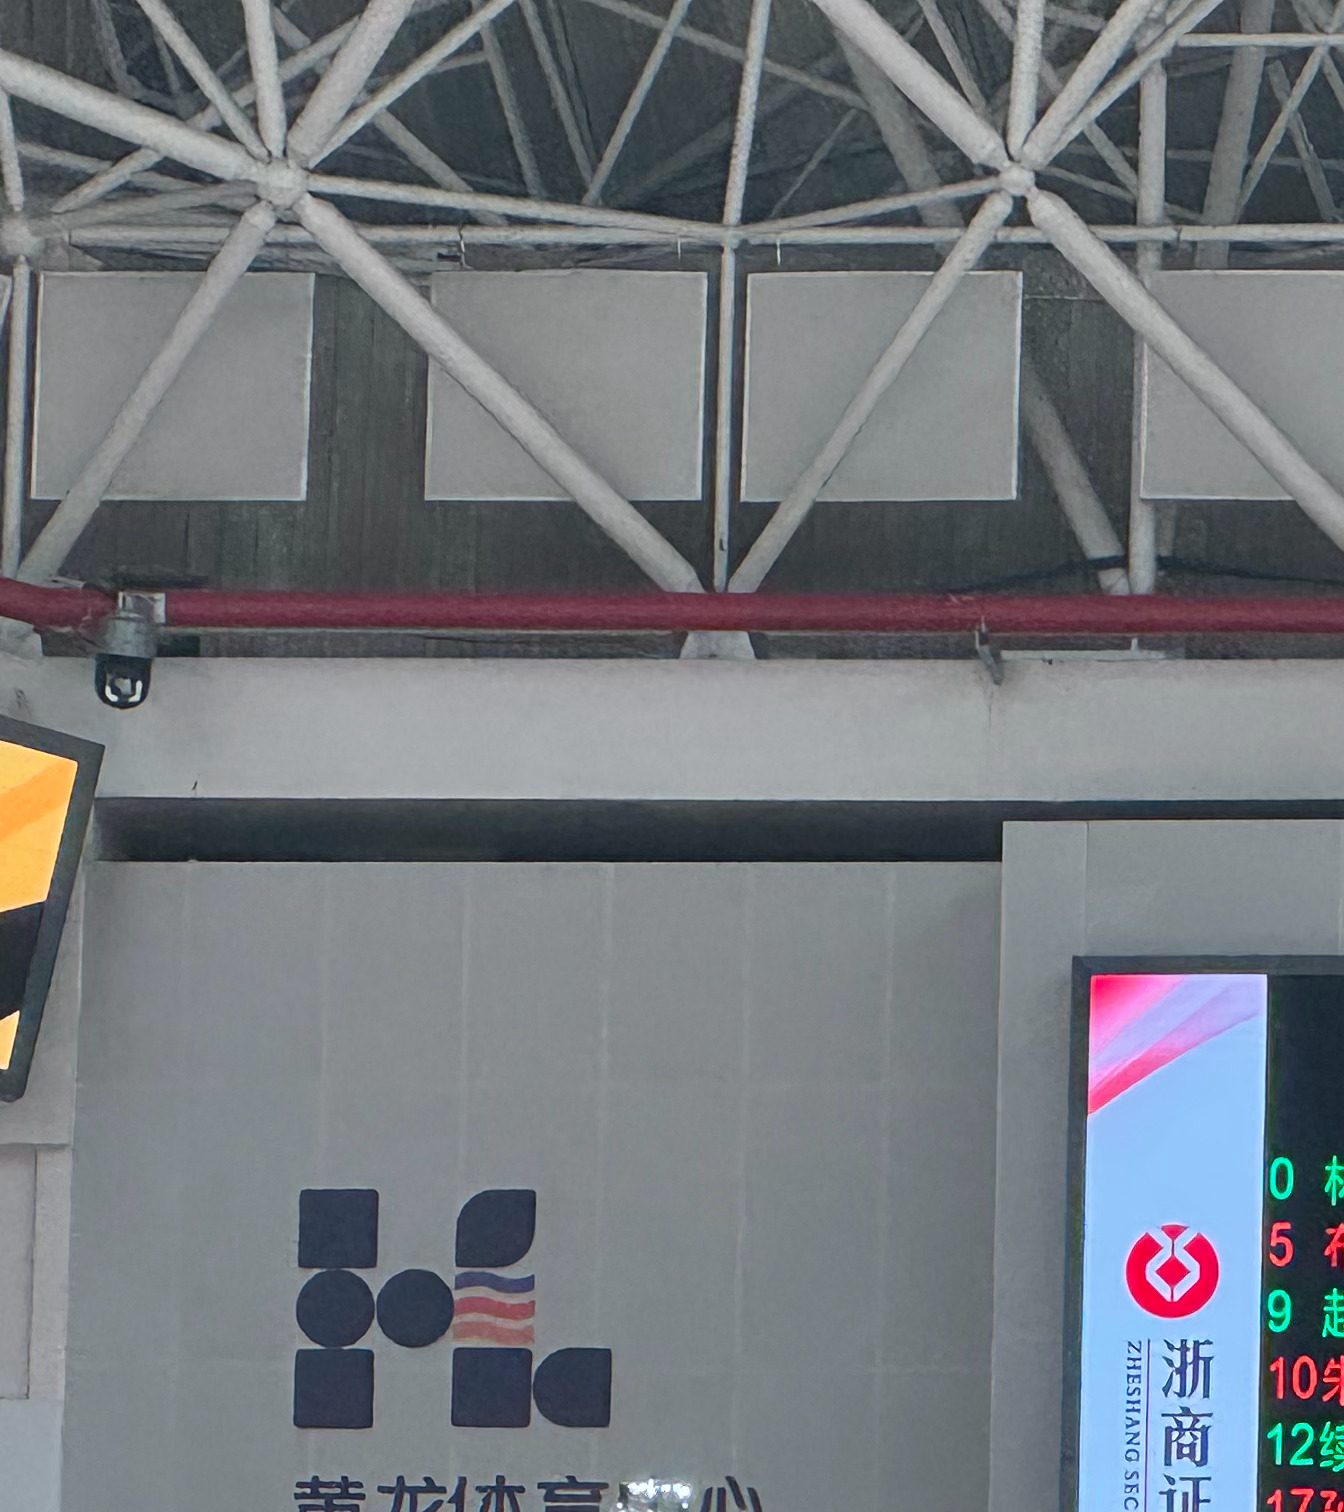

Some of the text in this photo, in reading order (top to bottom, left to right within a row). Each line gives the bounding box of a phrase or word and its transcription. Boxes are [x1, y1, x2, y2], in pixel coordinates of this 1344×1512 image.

[1268, 1156, 1295, 1201] 0
[1268, 1222, 1294, 1267] 5
[1266, 1289, 1292, 1333] 9
[1123, 1339, 1142, 1463] ZHESHANG
